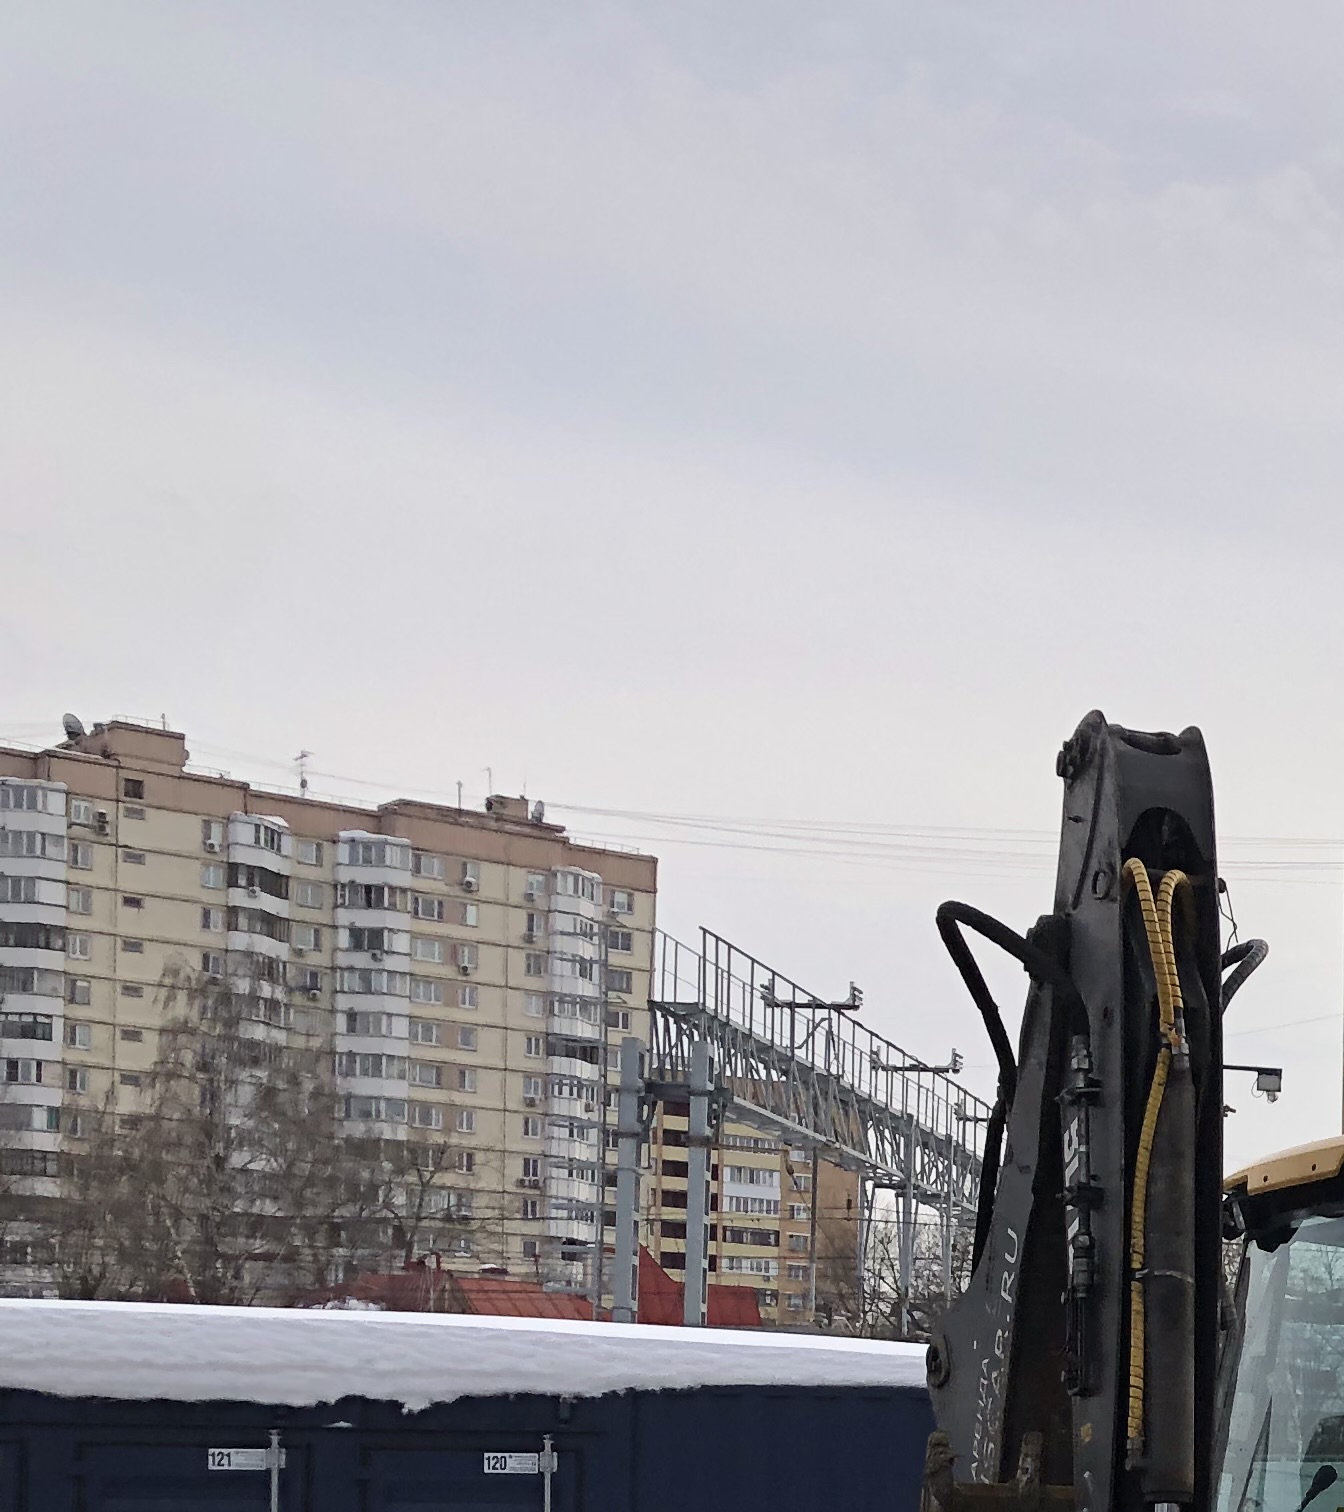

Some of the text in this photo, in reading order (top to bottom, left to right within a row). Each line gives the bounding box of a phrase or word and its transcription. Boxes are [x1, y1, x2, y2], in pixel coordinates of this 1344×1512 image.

[970, 1358, 990, 1481] АРЕНДА
[208, 1450, 232, 1468] 121
[485, 1455, 507, 1471] 120
